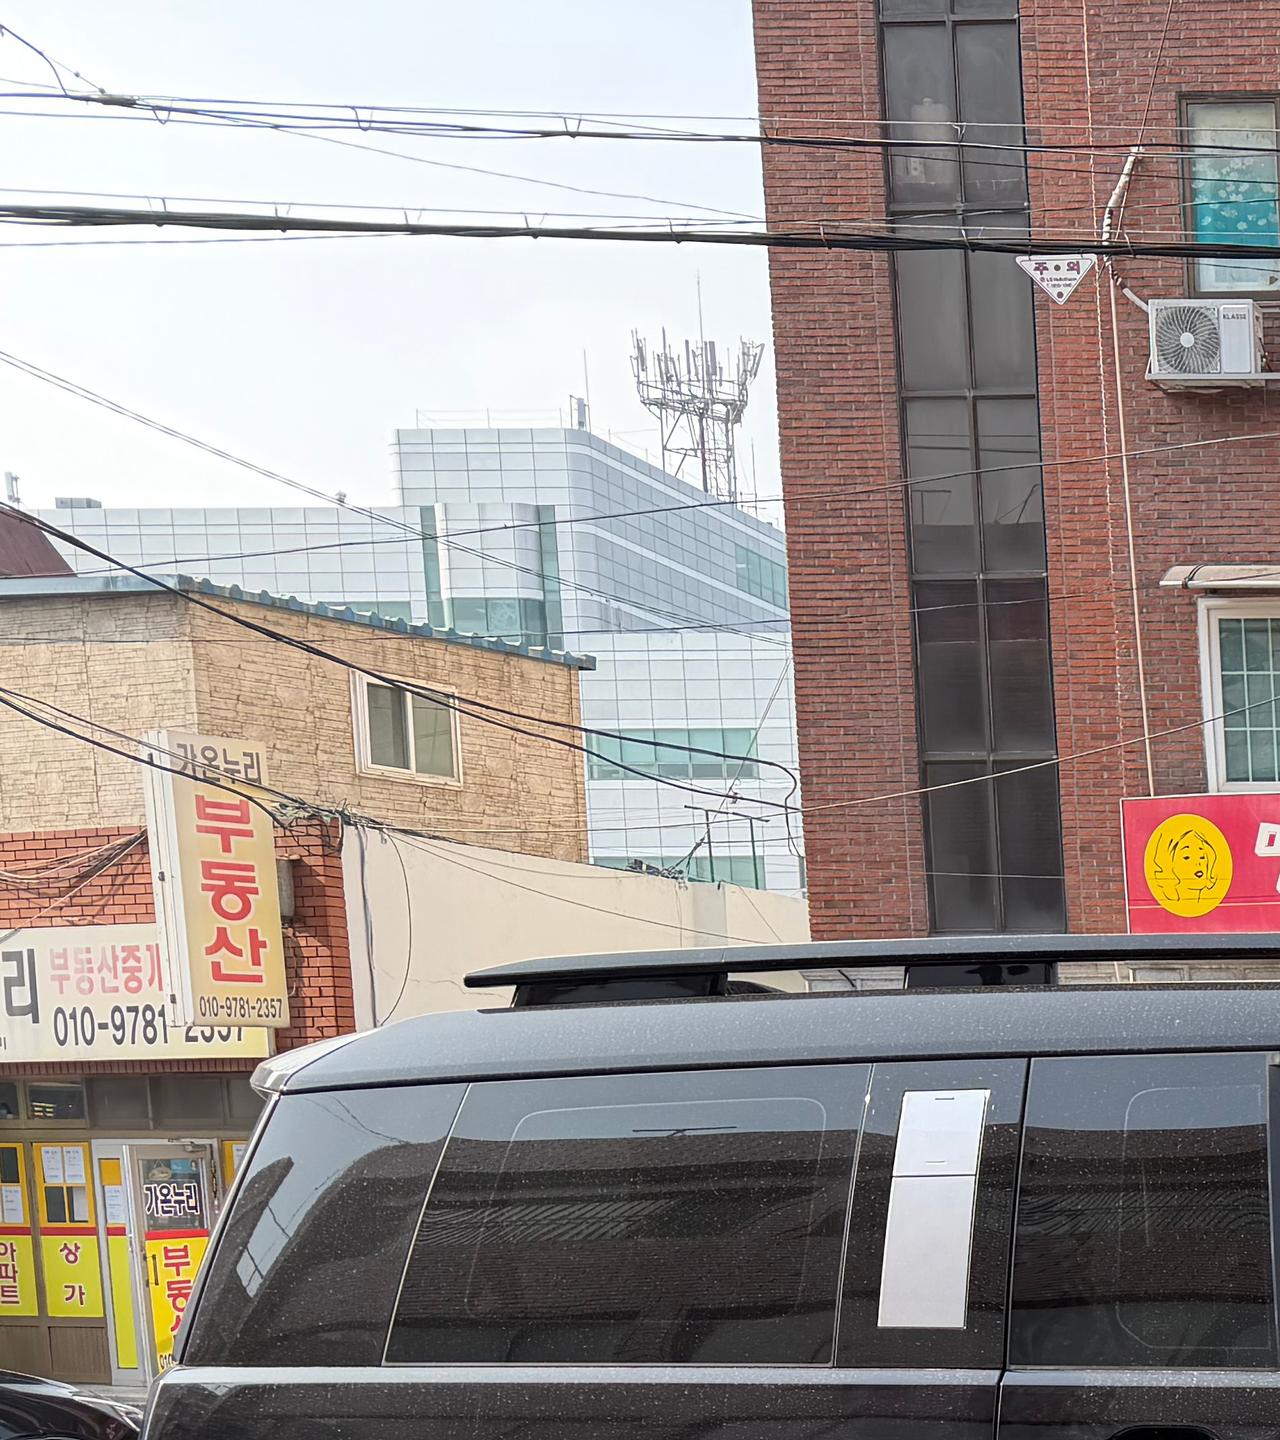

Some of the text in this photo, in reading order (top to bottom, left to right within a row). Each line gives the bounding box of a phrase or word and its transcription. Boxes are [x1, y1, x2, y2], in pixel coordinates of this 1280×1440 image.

[176, 743, 262, 785] 가온누리
[195, 794, 267, 984] 부동산
[53, 1003, 244, 1046] 010-9781
[199, 996, 283, 1019] 010-9781-2357
[144, 1184, 200, 1216] 가온누리
